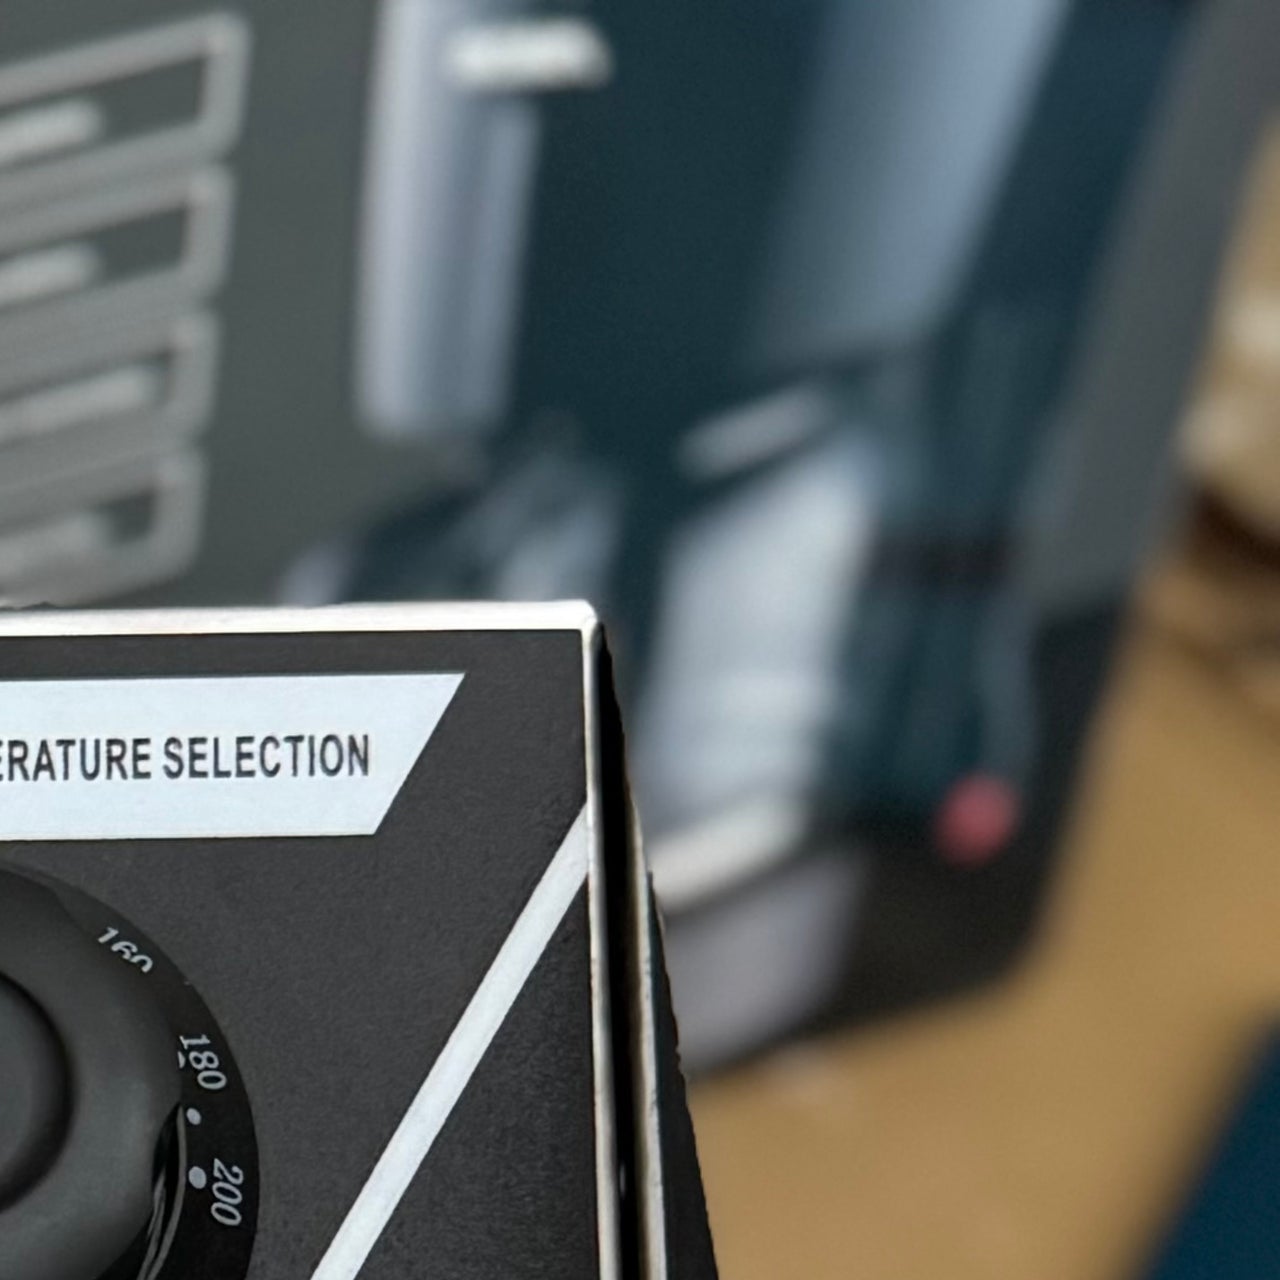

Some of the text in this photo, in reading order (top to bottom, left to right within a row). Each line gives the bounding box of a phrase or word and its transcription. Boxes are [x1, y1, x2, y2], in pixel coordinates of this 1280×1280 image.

[162, 734, 370, 780] SELECTION
[179, 1034, 228, 1091] 180
[210, 1157, 245, 1227] 200
